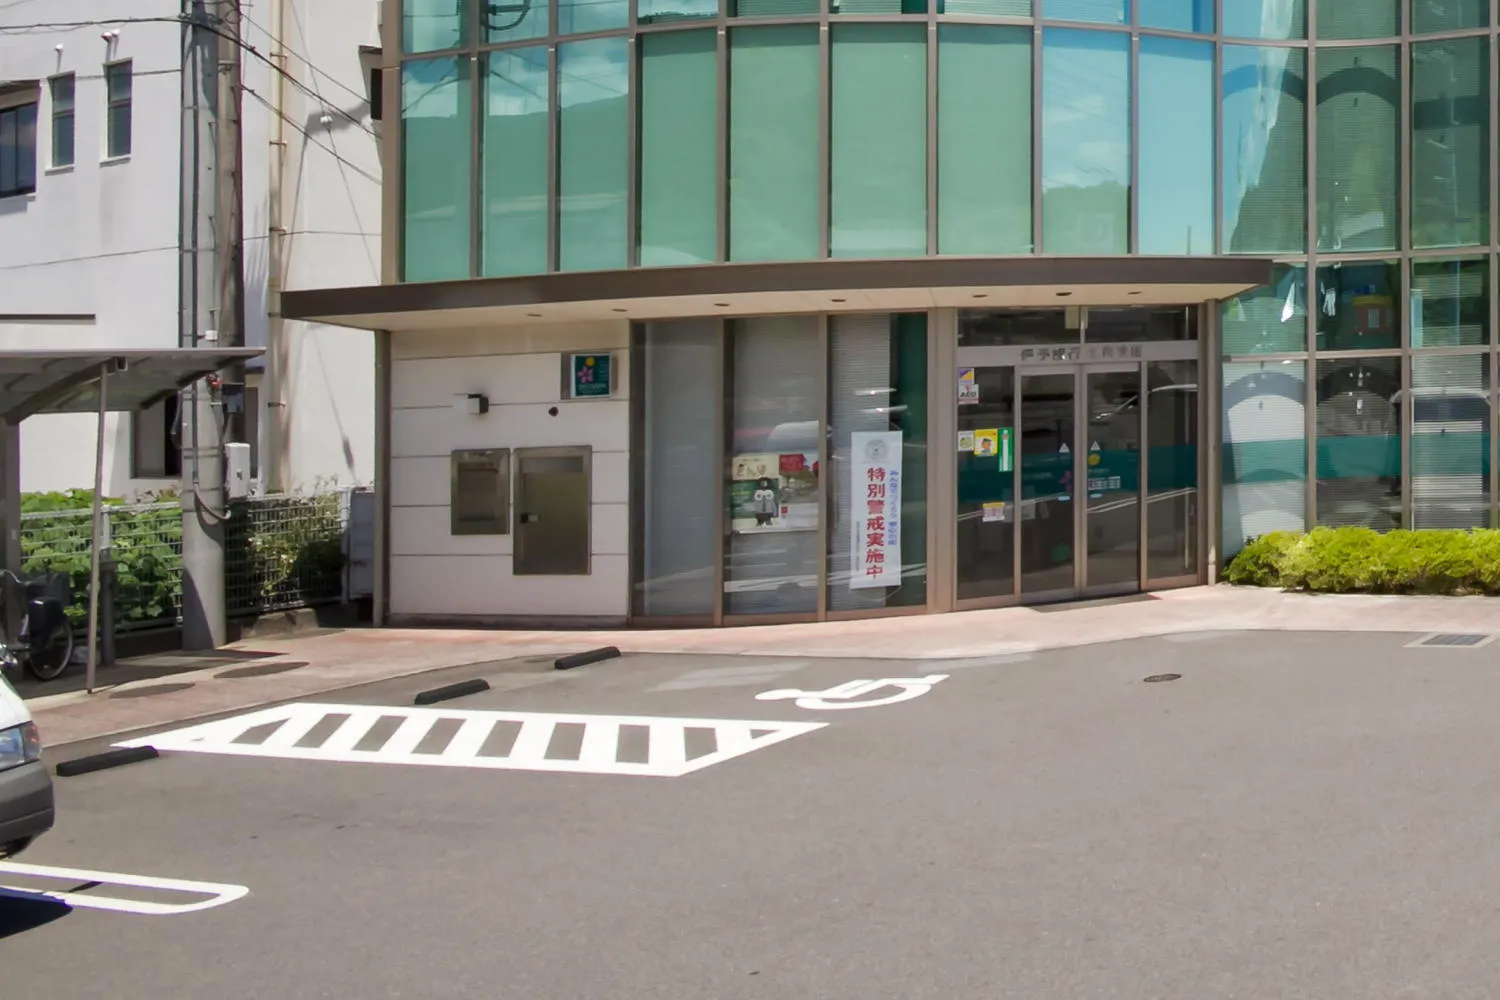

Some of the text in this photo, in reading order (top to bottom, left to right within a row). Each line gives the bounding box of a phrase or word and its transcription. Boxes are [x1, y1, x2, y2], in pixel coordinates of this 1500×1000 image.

[866, 467, 886, 579] 特別警戒実施中
